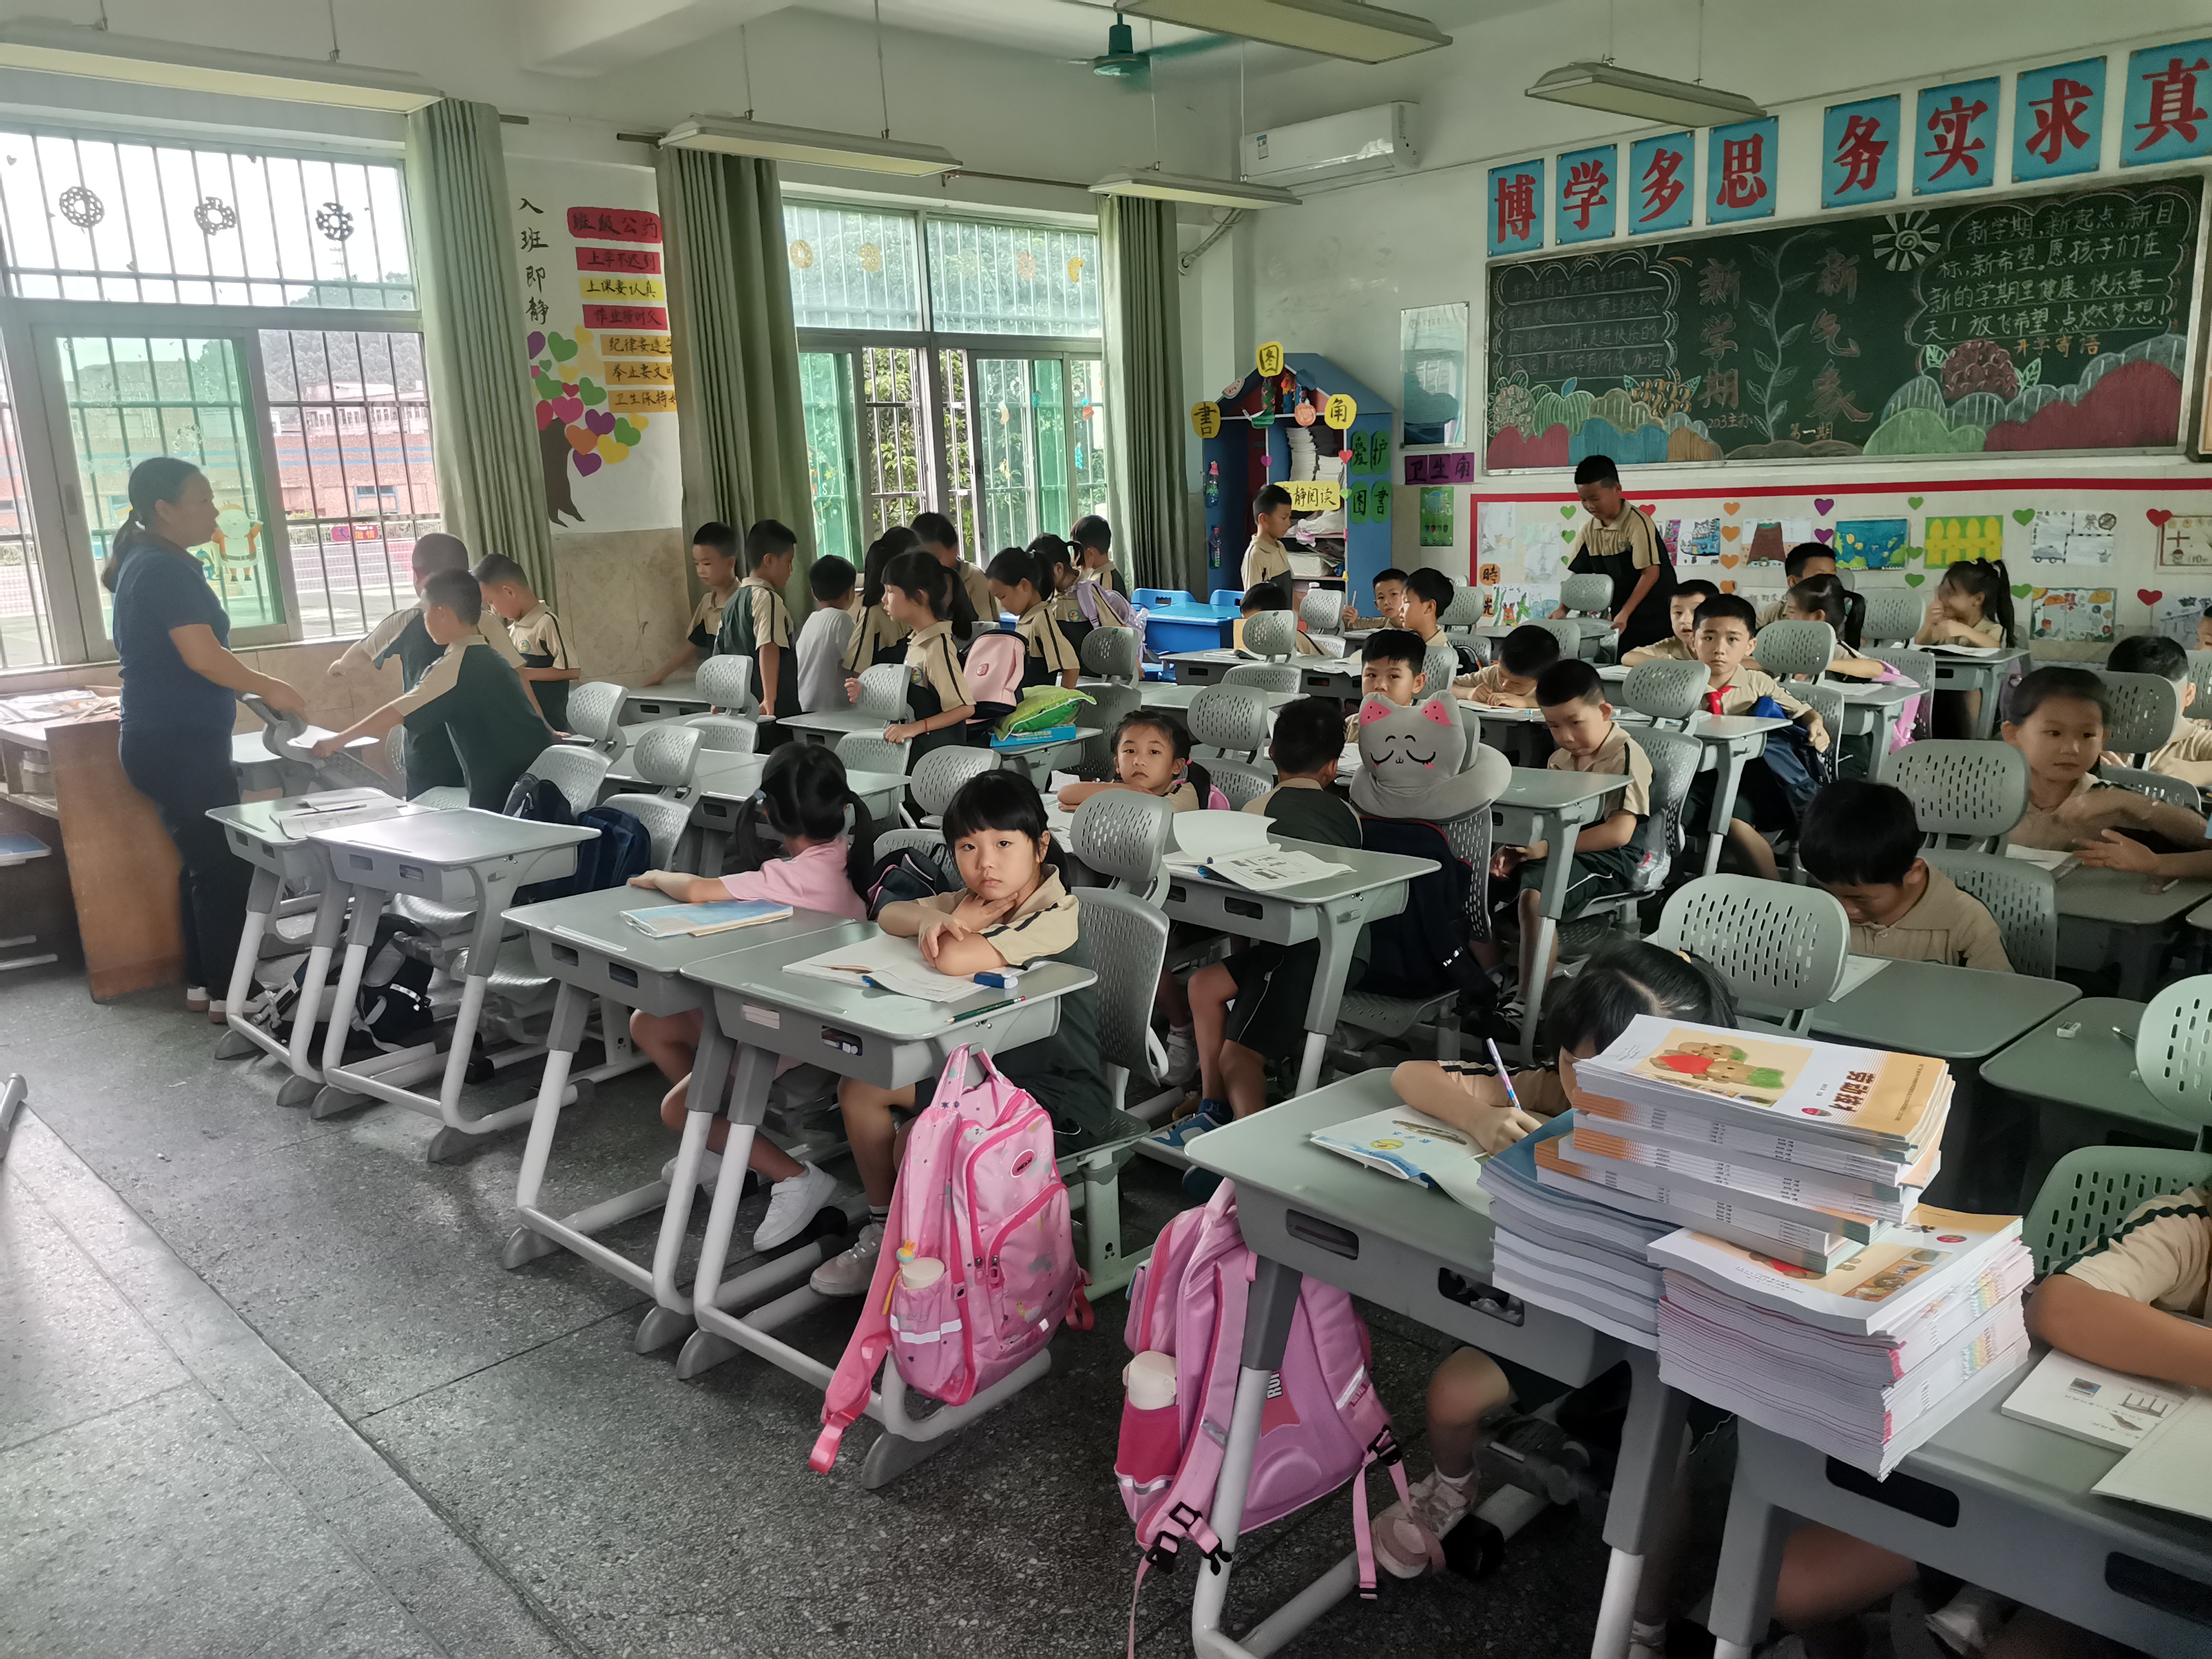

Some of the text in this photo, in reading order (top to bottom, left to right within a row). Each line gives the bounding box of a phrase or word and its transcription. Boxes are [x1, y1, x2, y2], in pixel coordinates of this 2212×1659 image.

[1494, 58, 2210, 243] 博学多思 务实求真
[518, 198, 549, 325] 入班即静
[586, 279, 656, 298] 上课要认真
[1698, 258, 1741, 409] 新学期
[2013, 332, 2100, 358] 开学寄语
[1407, 454, 1470, 481] 卫生角
